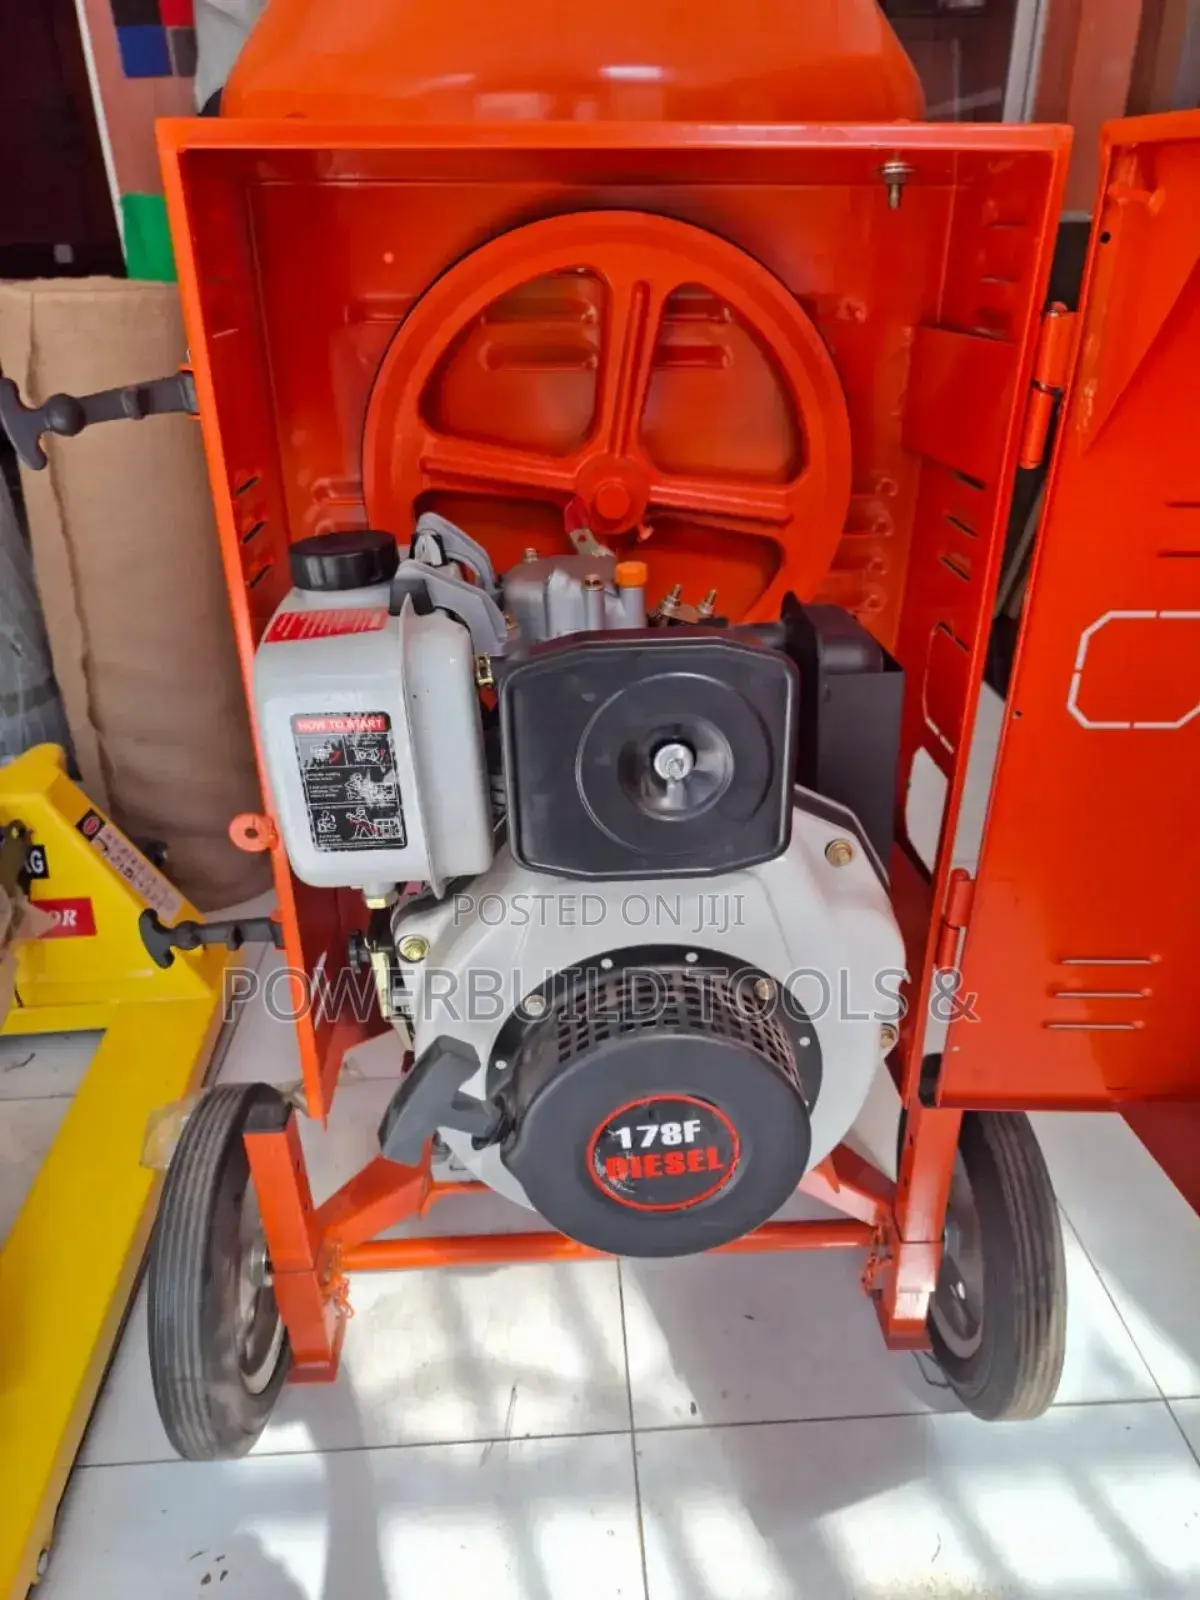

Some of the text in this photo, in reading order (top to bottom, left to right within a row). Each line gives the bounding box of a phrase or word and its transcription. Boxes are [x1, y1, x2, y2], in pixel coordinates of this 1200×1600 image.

[297, 717, 382, 731] HOW TO START
[616, 1119, 701, 1149] 178F
[605, 1146, 724, 1180] DIESEL
